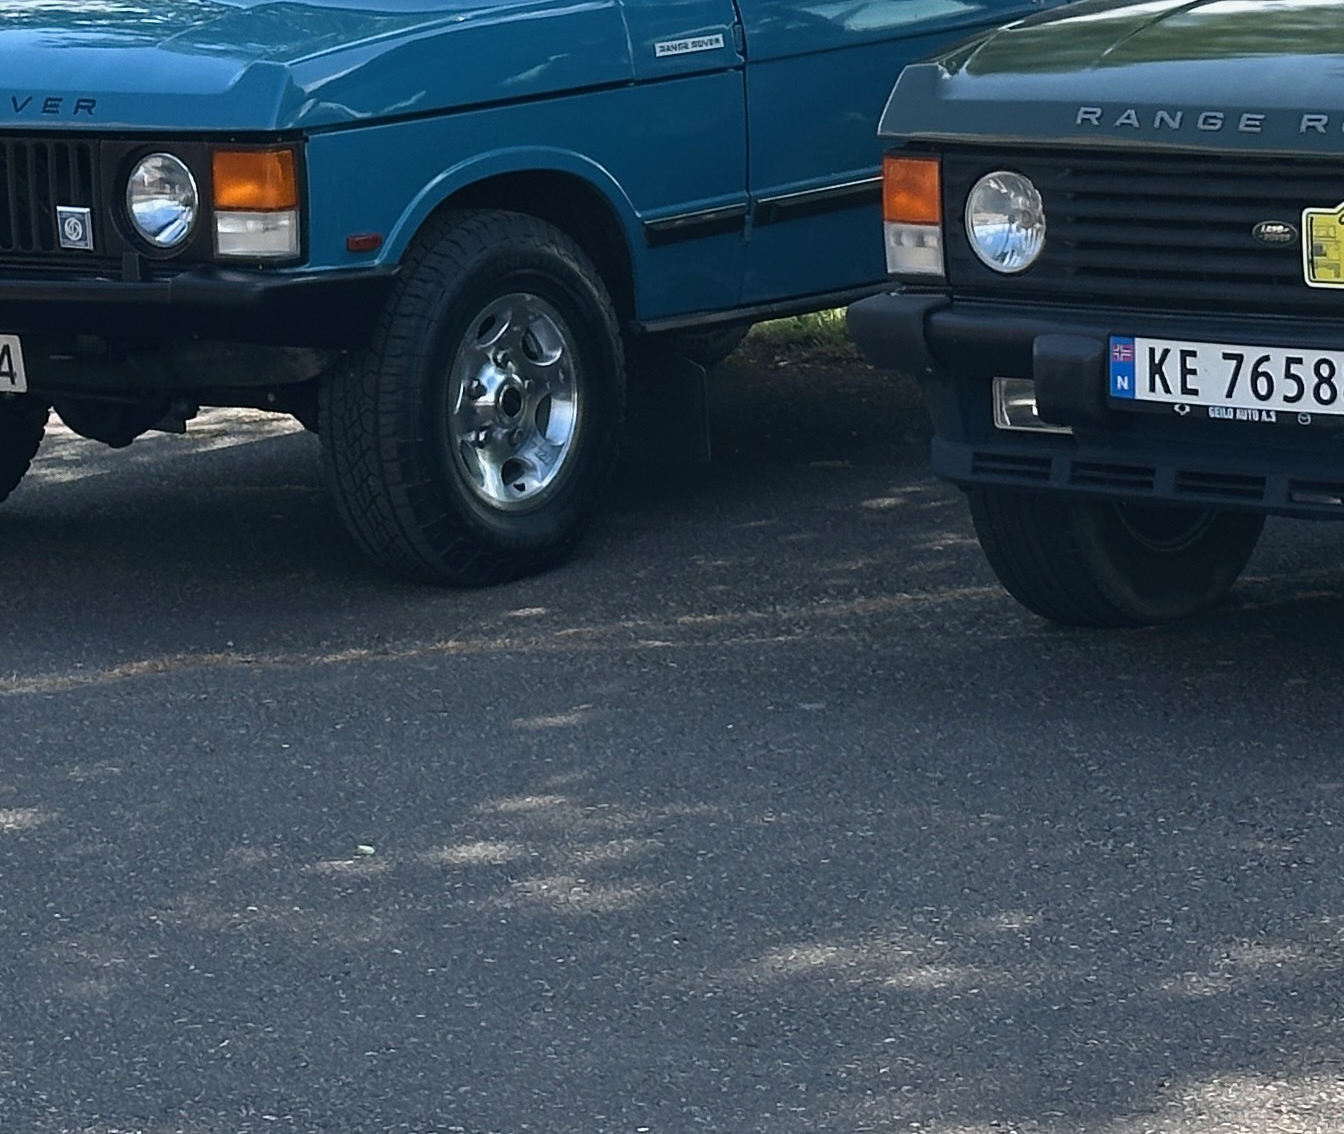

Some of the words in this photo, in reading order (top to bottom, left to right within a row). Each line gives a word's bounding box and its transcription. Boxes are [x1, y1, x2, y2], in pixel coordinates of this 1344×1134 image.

[1075, 106, 1266, 133] RANGE
[1147, 346, 1199, 397] KE
[1116, 375, 1129, 391] N
[1208, 406, 1234, 419] GEILO
